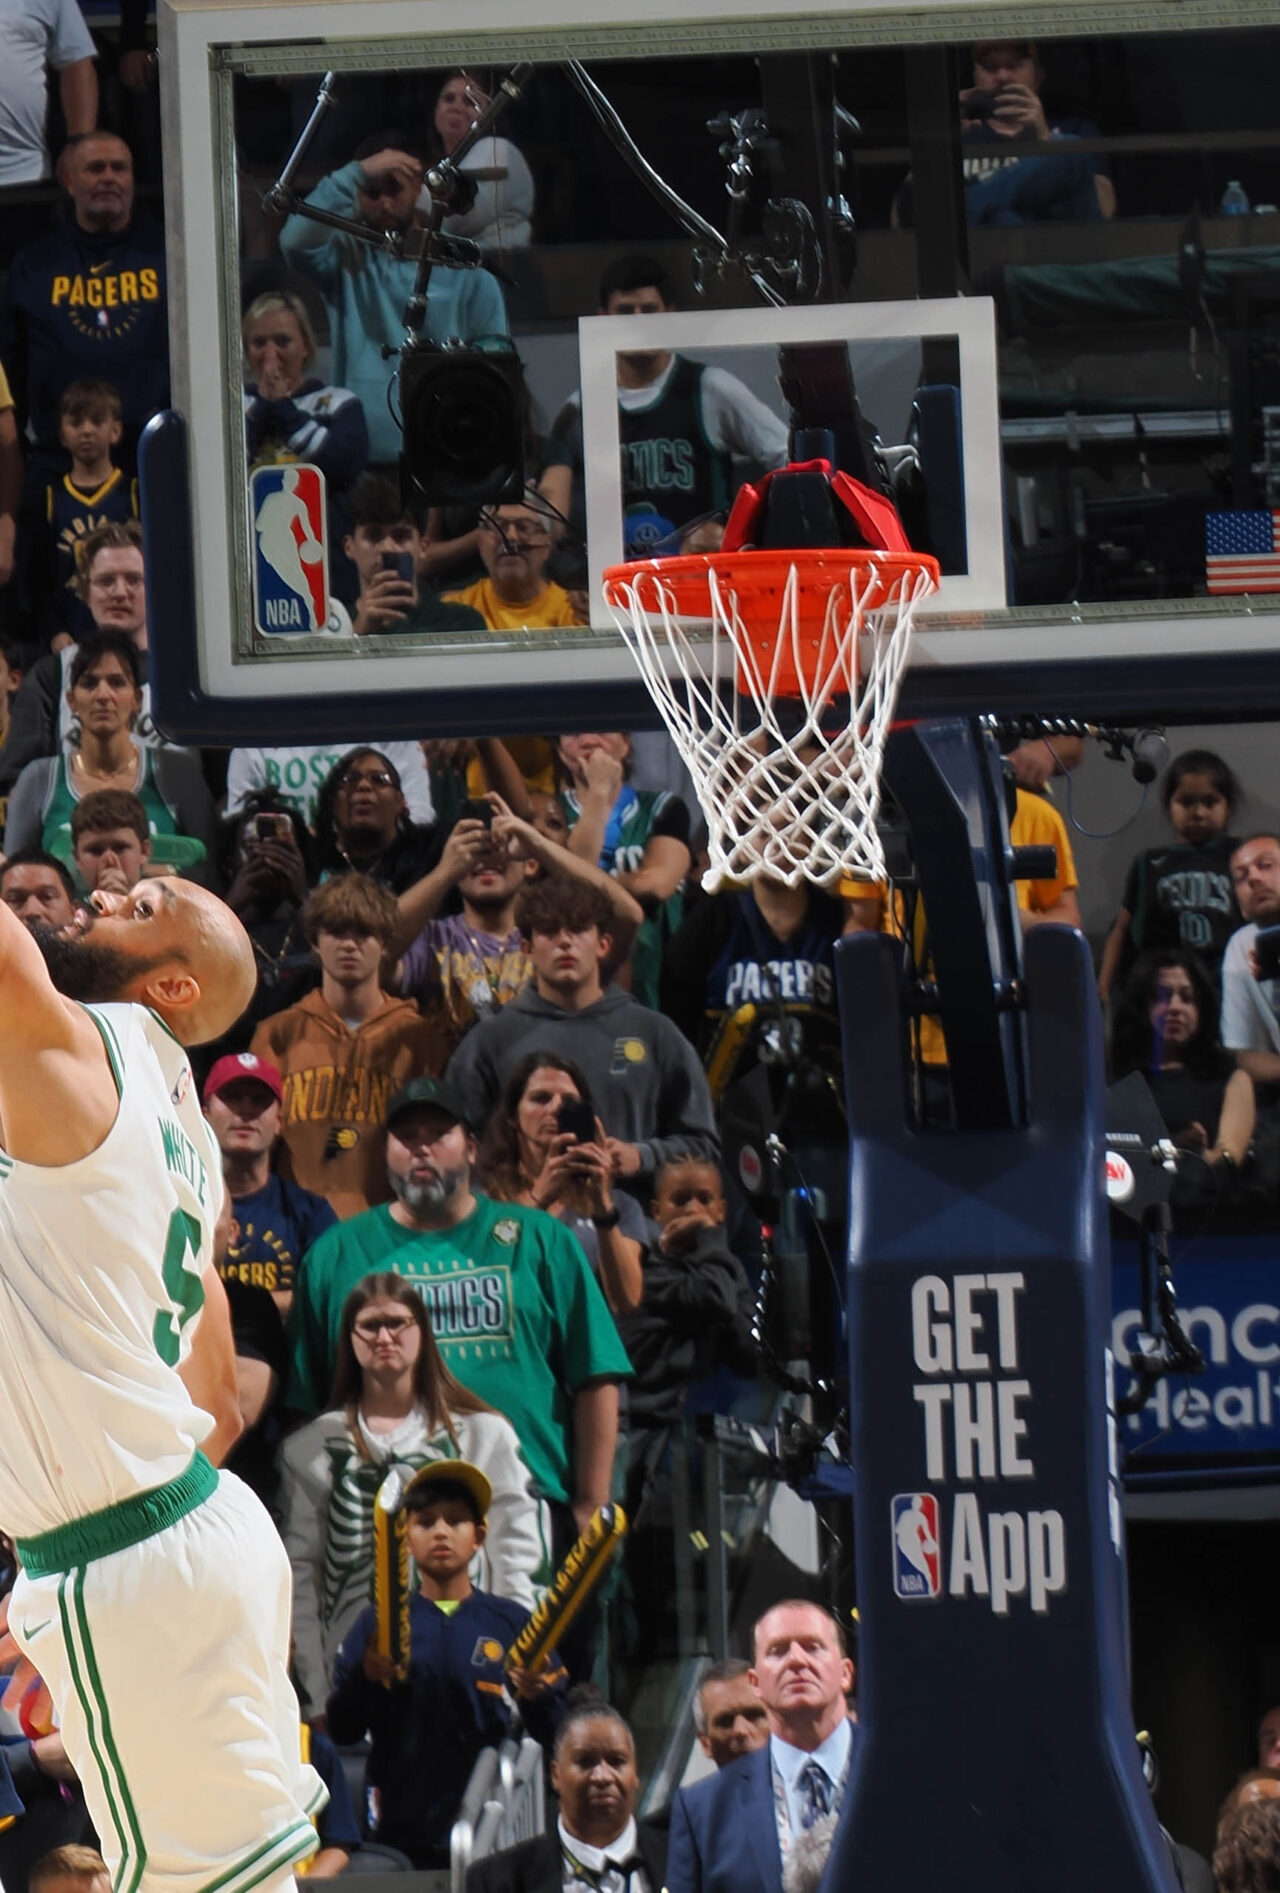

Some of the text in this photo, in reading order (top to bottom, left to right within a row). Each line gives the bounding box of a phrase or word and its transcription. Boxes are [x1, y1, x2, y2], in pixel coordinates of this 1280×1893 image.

[51, 267, 158, 307] PACERS
[265, 598, 302, 627] NBA
[157, 1116, 207, 1207] WHITE
[911, 1272, 1027, 1374] GET
[913, 1379, 1036, 1484] THE
[900, 1573, 927, 1593] NBA
[949, 1492, 1068, 1618] App
